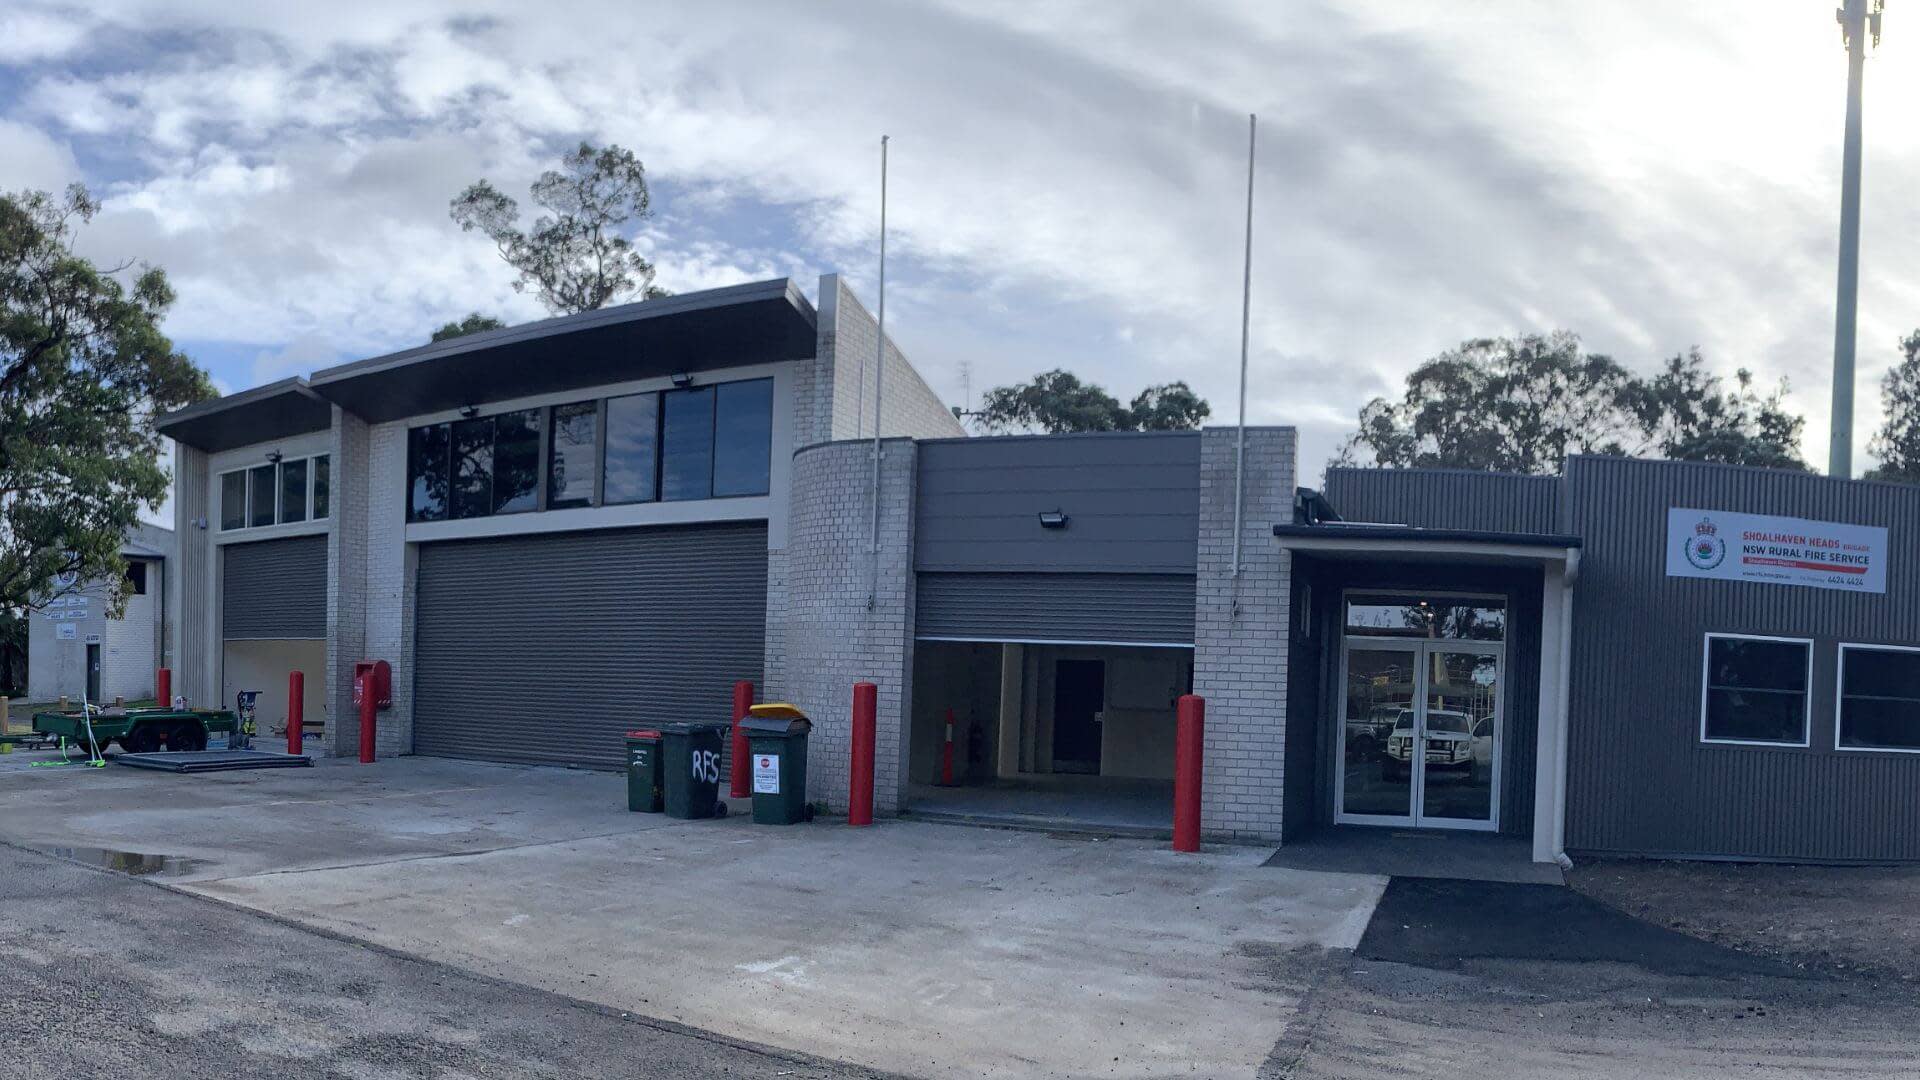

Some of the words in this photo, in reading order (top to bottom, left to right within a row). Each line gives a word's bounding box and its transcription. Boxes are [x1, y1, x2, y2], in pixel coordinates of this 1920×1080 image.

[1743, 531, 1806, 545] SHOALHAVEN
[1809, 537, 1840, 549] HEADS
[1743, 545, 1766, 555] NSW
[1769, 546, 1801, 558] RURAL
[1805, 549, 1826, 561] FIRE
[1829, 552, 1870, 565] SERVICE
[1827, 575, 1845, 584] 4424
[1847, 577, 1864, 586] 4424
[692, 749, 720, 784] RFS
